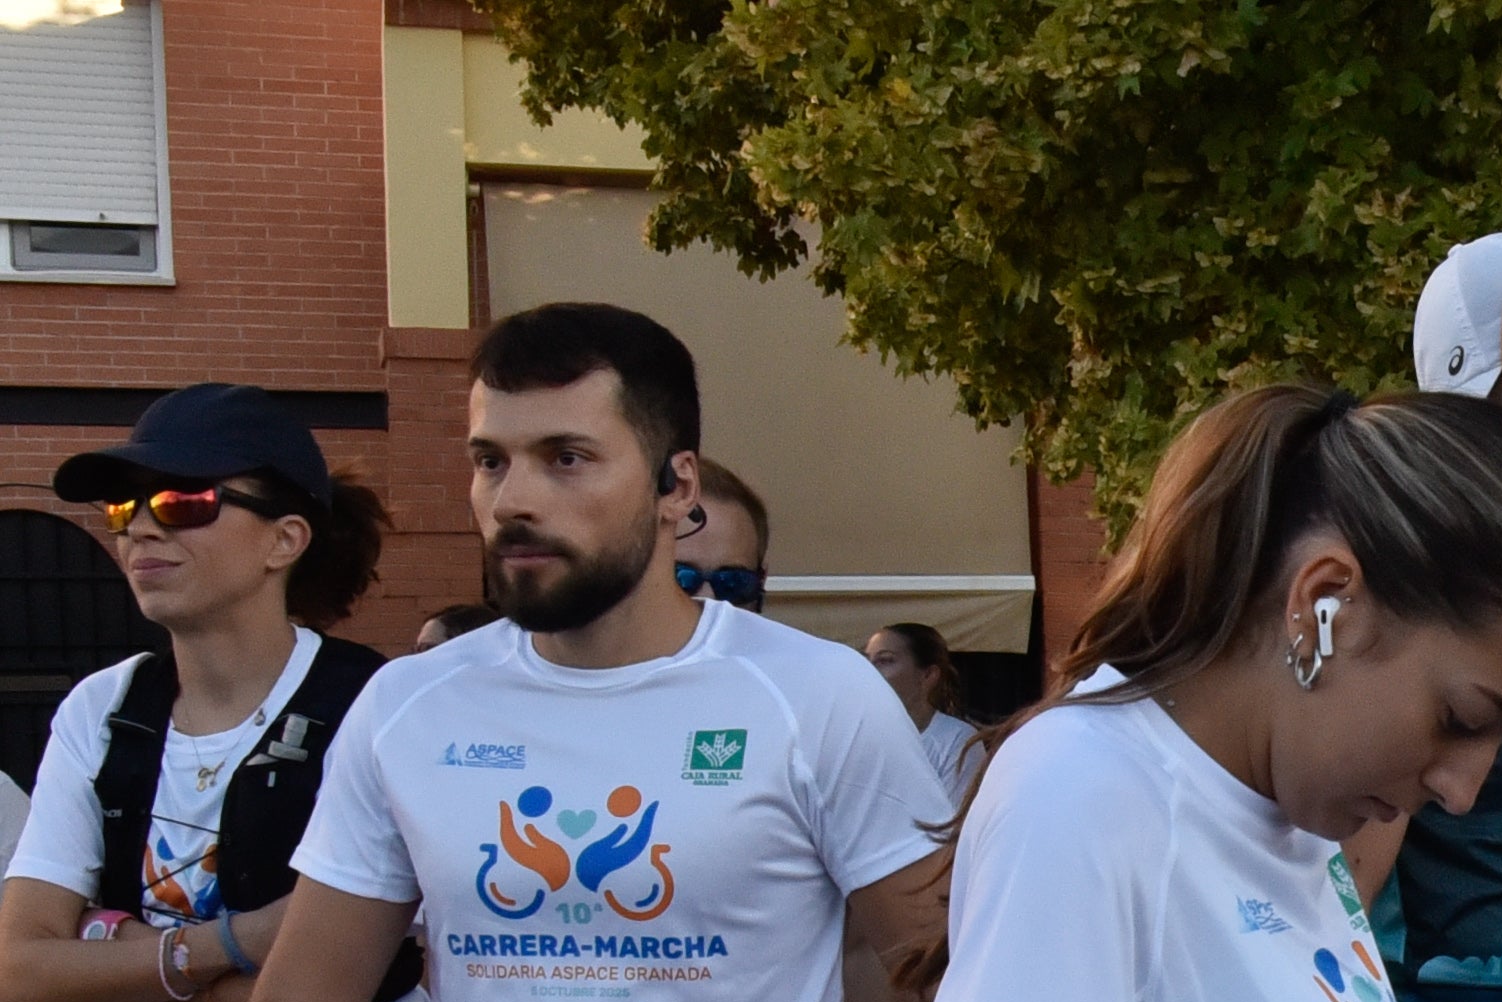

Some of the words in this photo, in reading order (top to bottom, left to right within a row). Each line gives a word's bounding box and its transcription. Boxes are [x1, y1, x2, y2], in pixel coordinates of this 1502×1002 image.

[465, 743, 527, 761] ASPACE
[447, 933, 729, 960] CARRERA-MARCHA
[466, 963, 547, 980] SOLIDARIA
[550, 965, 620, 981] ASPACE
[623, 966, 713, 981] GRANADA
